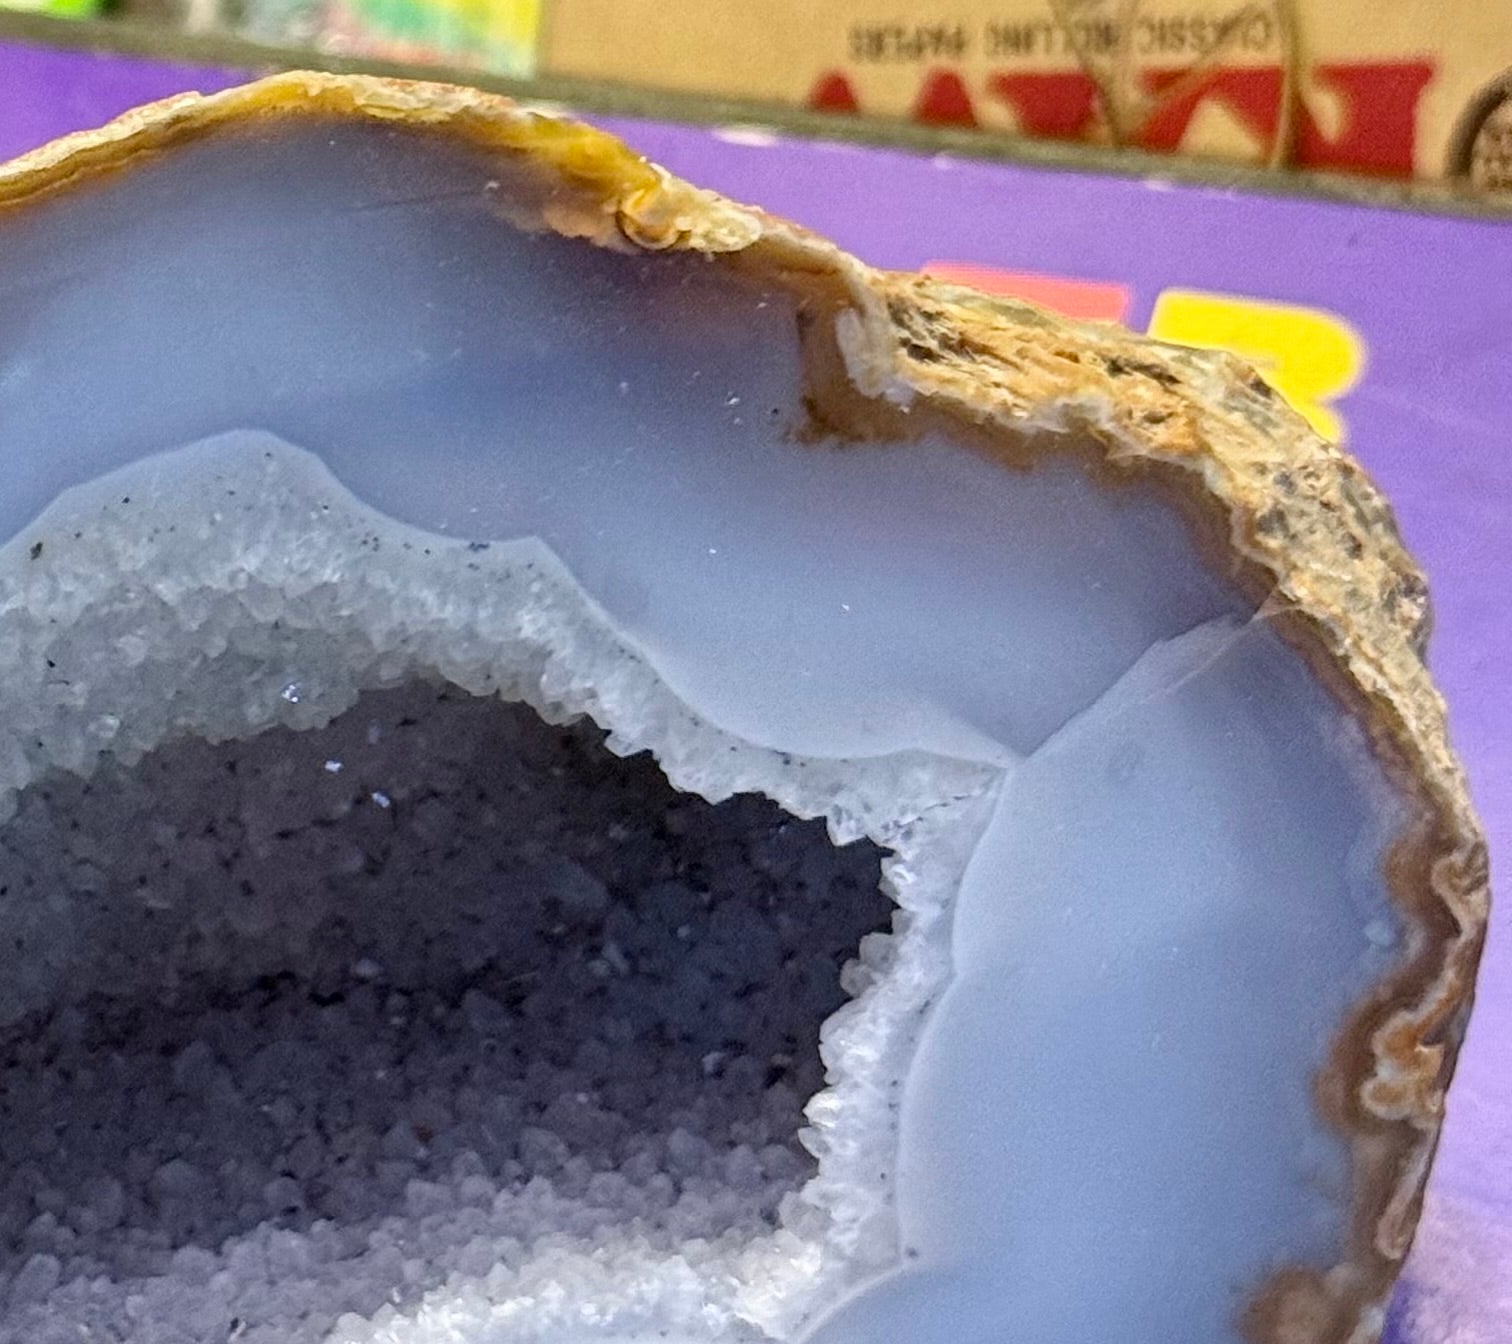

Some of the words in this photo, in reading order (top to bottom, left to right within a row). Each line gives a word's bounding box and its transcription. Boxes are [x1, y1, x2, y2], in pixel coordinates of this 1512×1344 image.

[846, 20, 966, 60] PAPERS
[989, 11, 1122, 57] ROLLING
[1140, 9, 1274, 53] CLASSIC
